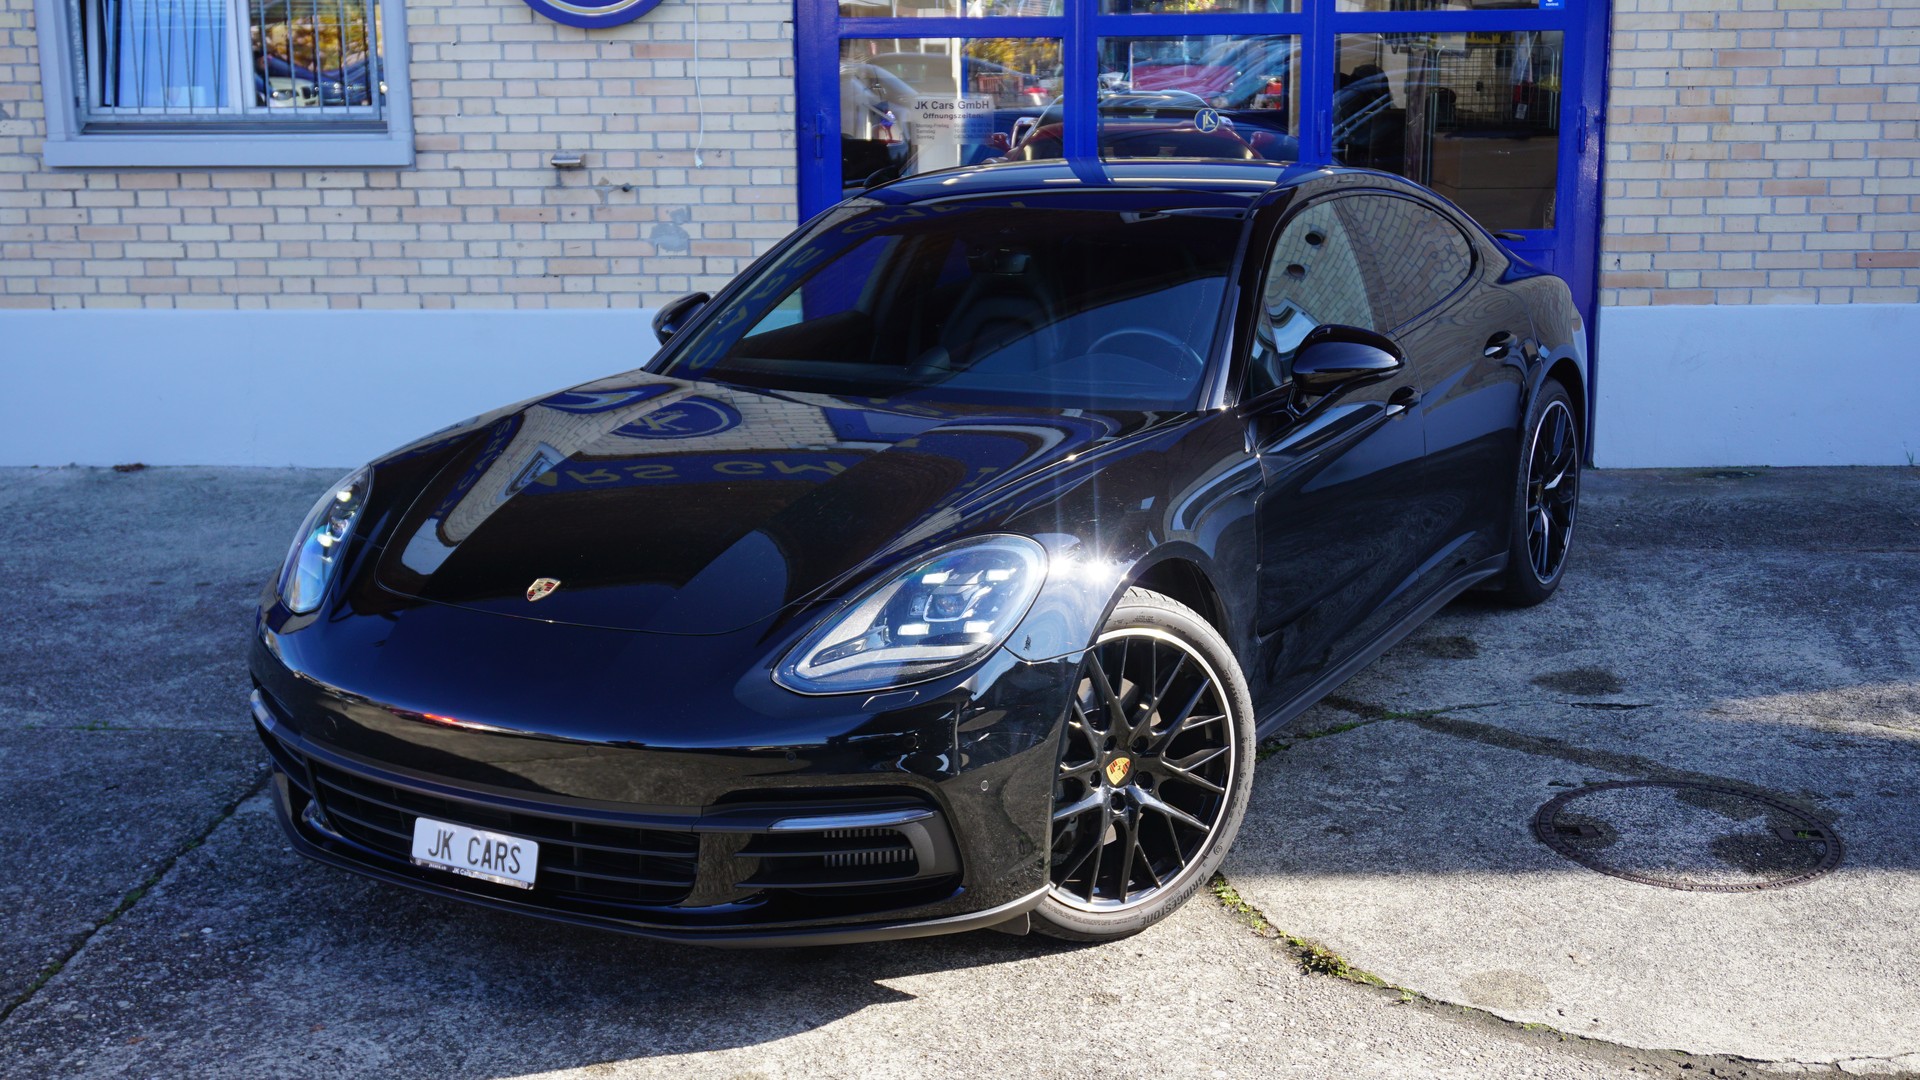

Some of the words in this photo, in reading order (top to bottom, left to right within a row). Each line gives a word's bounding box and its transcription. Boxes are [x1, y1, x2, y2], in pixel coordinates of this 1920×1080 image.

[914, 100, 928, 110] JK
[931, 100, 954, 110] Cars
[957, 100, 989, 110] GmbH
[922, 112, 984, 120] Öffnungszeiten:
[428, 829, 455, 861] JK
[467, 836, 521, 874] CARS
[1140, 872, 1206, 926] BRIDGESTONE
